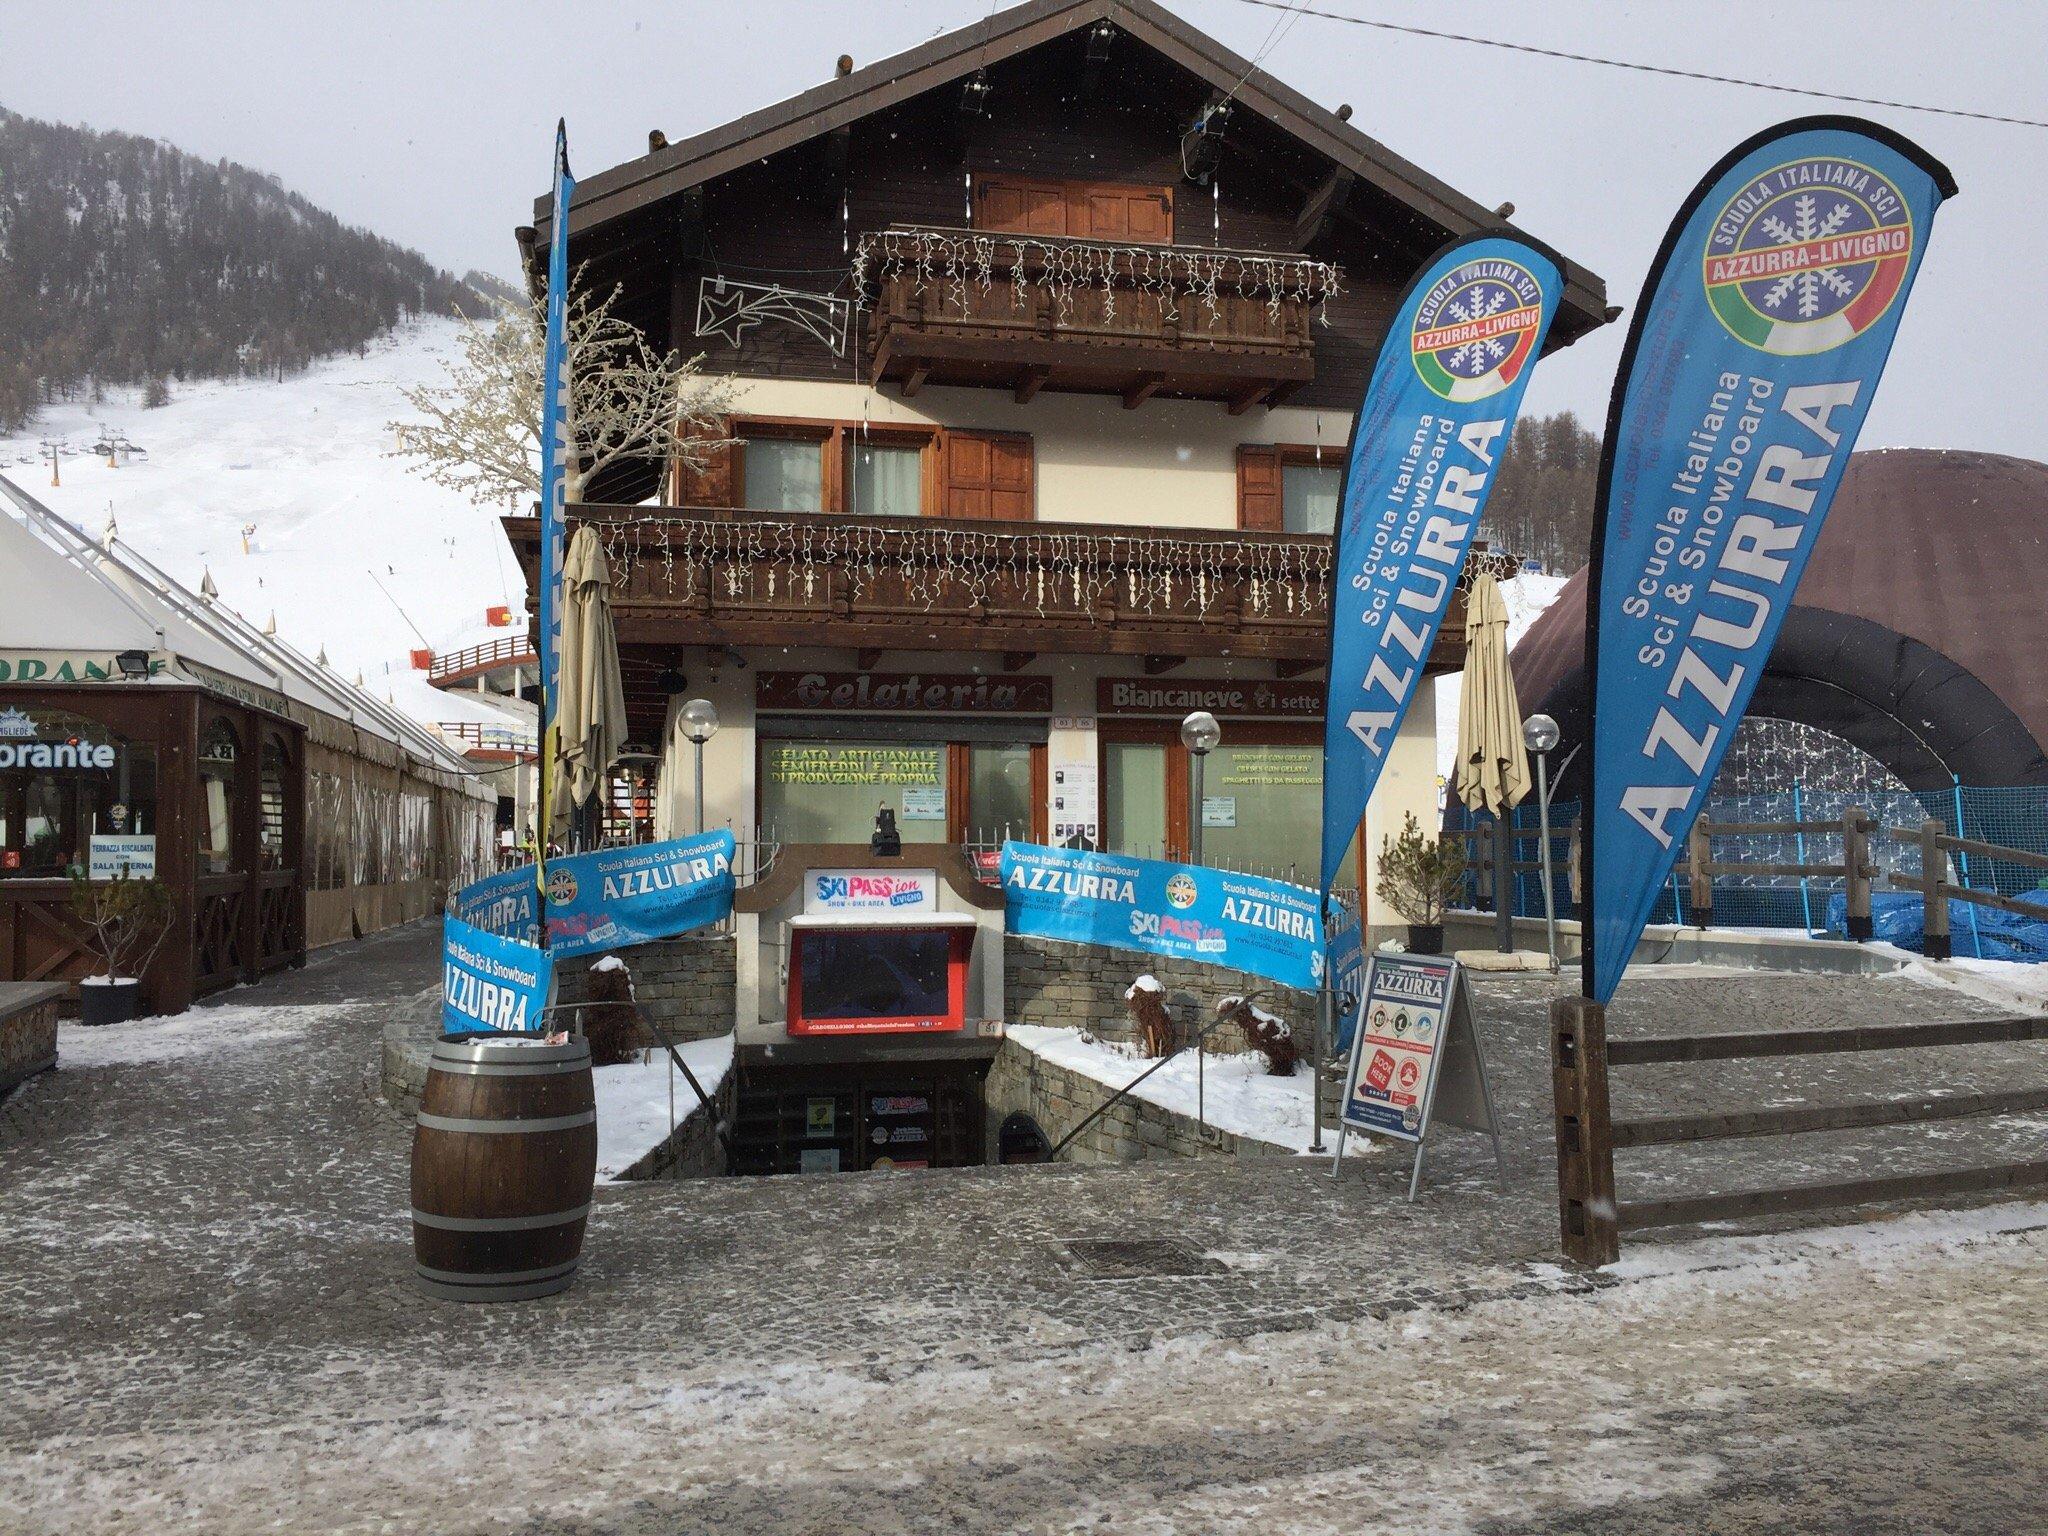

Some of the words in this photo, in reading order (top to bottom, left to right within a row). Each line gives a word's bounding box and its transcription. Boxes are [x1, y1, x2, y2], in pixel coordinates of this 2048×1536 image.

[1715, 182, 1774, 246] SCUOLA
[1778, 164, 1870, 193] ITALIANA
[1869, 185, 1900, 219] SCI
[1712, 230, 1906, 281] AZZURRA-LIVIGNO
[1419, 278, 1458, 325] SCUOLA
[1460, 263, 1519, 283] ITALIANA
[1516, 277, 1538, 301] SCI
[1678, 376, 1775, 570] Snowboard
[1351, 509, 1398, 591] Scuola
[1387, 414, 1434, 503] Italiana
[1622, 505, 1690, 619] Scuola
[1671, 370, 1742, 495] Italiana
[1361, 587, 1391, 627] Sci
[1380, 565, 1401, 582] &
[1391, 417, 1455, 556] Snowboard
[1345, 417, 1507, 759] AZZURRA
[1664, 582, 1694, 605] &
[1618, 378, 1863, 850] AZZURRA
[1637, 613, 1680, 668] Sci
[797, 673, 1018, 709] Gelateria
[1112, 682, 1243, 709] Biancaneve
[1281, 696, 1321, 710] sette
[771, 749, 830, 761] GELATO
[838, 749, 939, 762] ARTIGIANALE
[771, 761, 866, 773] SEMIFREDDI
[872, 761, 883, 772] E
[891, 761, 938, 773] TORTE
[772, 772, 785, 784] DI
[789, 772, 880, 785] PRODUZIONE
[881, 773, 939, 785] PROPRIA
[92, 844, 120, 853] TERRAZZA
[92, 862, 114, 870] SALA
[116, 862, 153, 870] INERNA
[597, 860, 623, 873] Scuola
[623, 855, 653, 869] Italiana
[654, 850, 668, 862] Sci
[669, 849, 677, 860] &
[676, 838, 726, 858] Snowboard
[1011, 851, 1040, 864] Scuola
[1041, 854, 1071, 868] Italiana
[1072, 859, 1086, 870] Sci
[1087, 860, 1094, 871] &
[1095, 862, 1140, 878] Snowboard
[602, 851, 730, 902] AZZURRA
[1006, 865, 1136, 904] AZZURRA
[891, 891, 923, 906] LIVIGNO
[1222, 881, 1246, 895] Scuola
[1247, 886, 1270, 900] Italiana
[1270, 891, 1280, 902] Sci
[1280, 893, 1286, 904] &
[1287, 895, 1317, 914] Snowboard
[1221, 896, 1316, 943] AZZURRA
[475, 952, 485, 971] Sci
[485, 957, 492, 974] &
[493, 959, 537, 988] Snowboard
[1375, 973, 1443, 998] AZZURRA
[1370, 1067, 1388, 1085] HERE
[1374, 1054, 1393, 1075] BOOK
